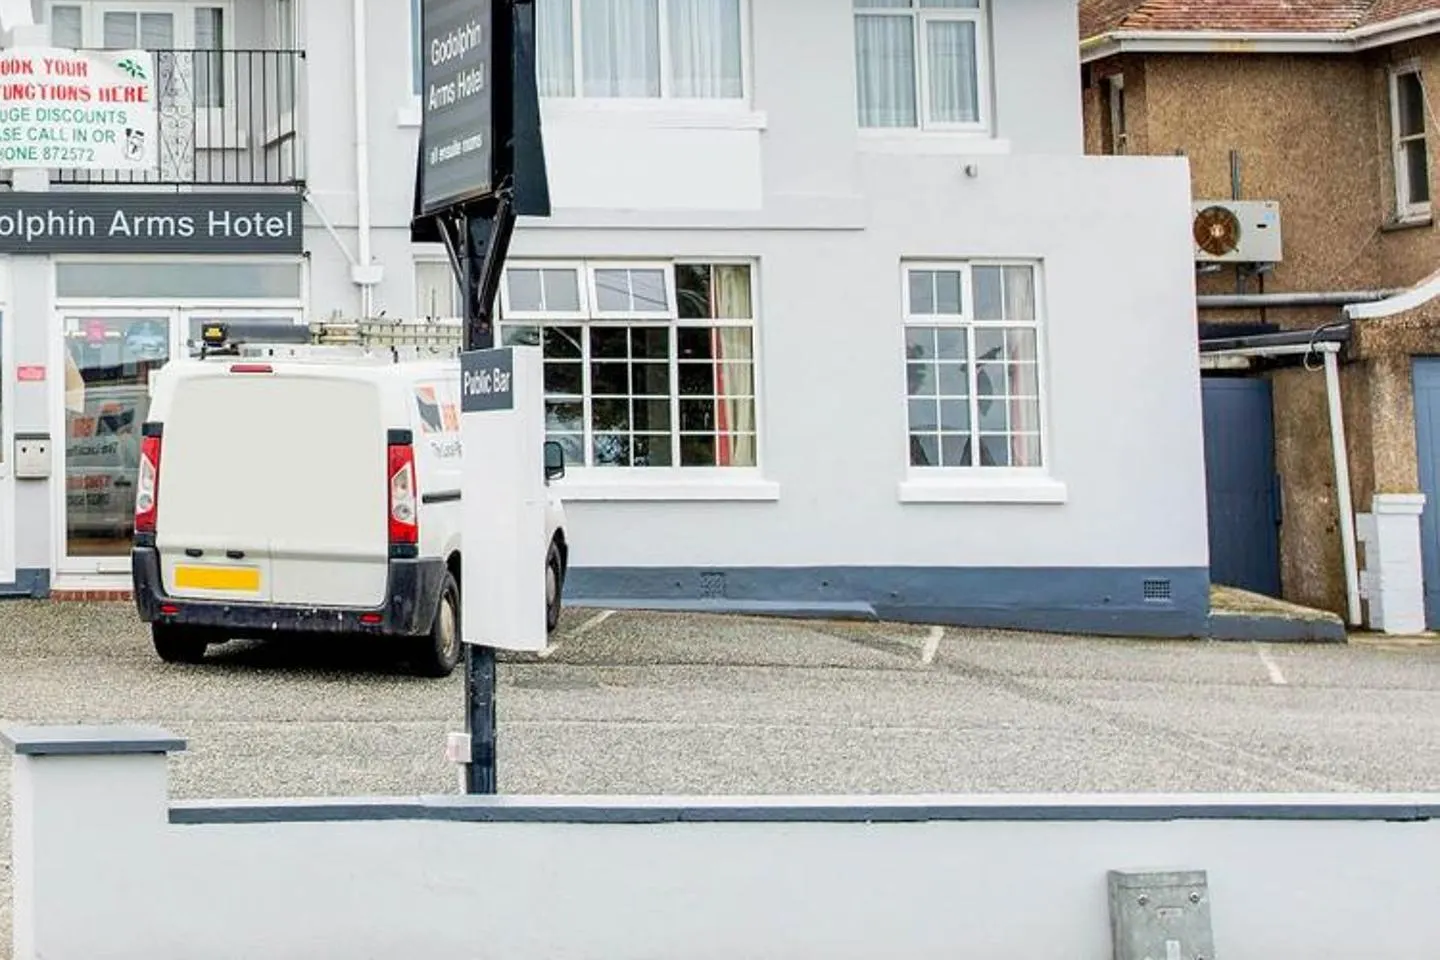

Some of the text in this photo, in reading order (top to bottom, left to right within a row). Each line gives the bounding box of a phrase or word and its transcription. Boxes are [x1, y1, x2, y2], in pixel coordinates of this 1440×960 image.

[431, 19, 481, 66] Godolphin
[43, 58, 88, 78] YOUR
[98, 85, 150, 103] HERE
[428, 62, 484, 111] Arms Hotel
[35, 107, 128, 125] DISCOUNTS
[26, 127, 68, 142] CALL
[72, 127, 88, 142] IN
[91, 128, 117, 144] OR
[42, 146, 95, 162] 872572
[108, 209, 196, 238] Arms
[208, 210, 294, 238] Hotel
[463, 367, 511, 396] Public Bar
